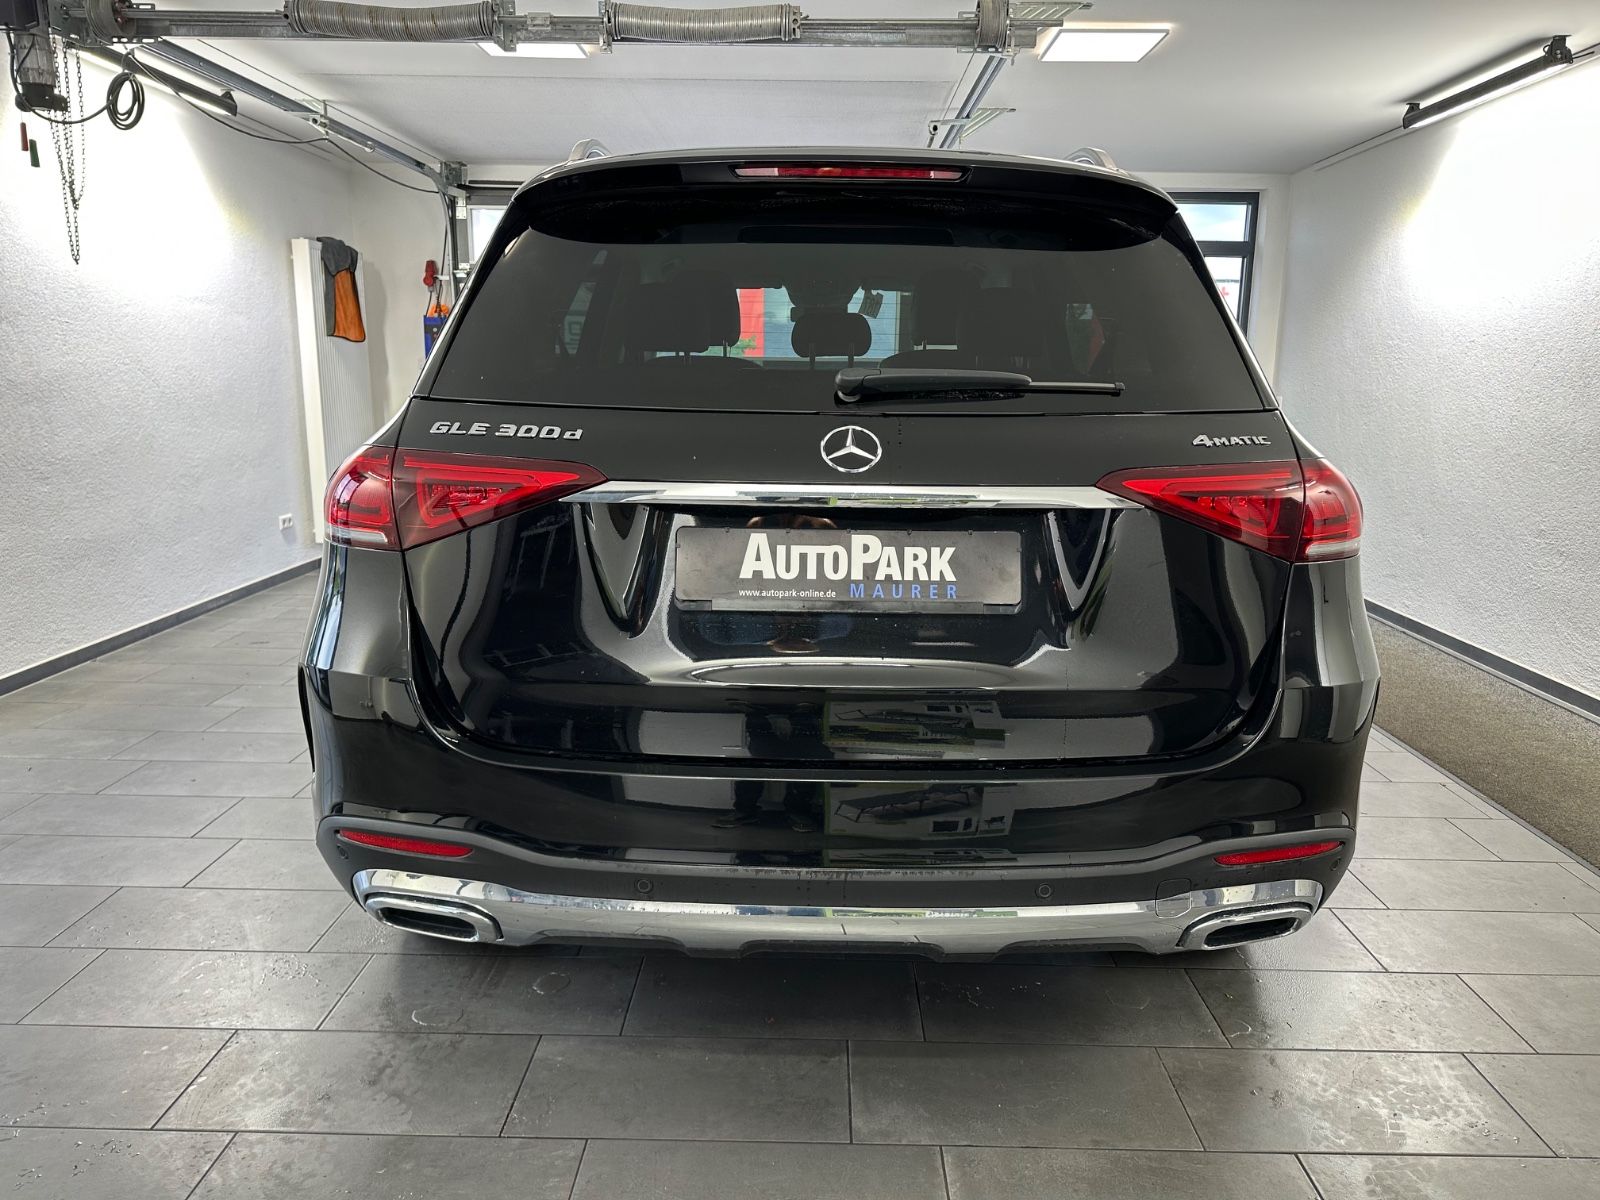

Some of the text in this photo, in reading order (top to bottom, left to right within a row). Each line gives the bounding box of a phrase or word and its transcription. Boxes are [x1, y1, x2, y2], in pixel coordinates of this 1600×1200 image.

[429, 421, 491, 435] GLE
[1192, 434, 1272, 447] 4MATIC
[738, 588, 836, 599] www.autopark-online.de
[850, 584, 957, 599] MAURER
